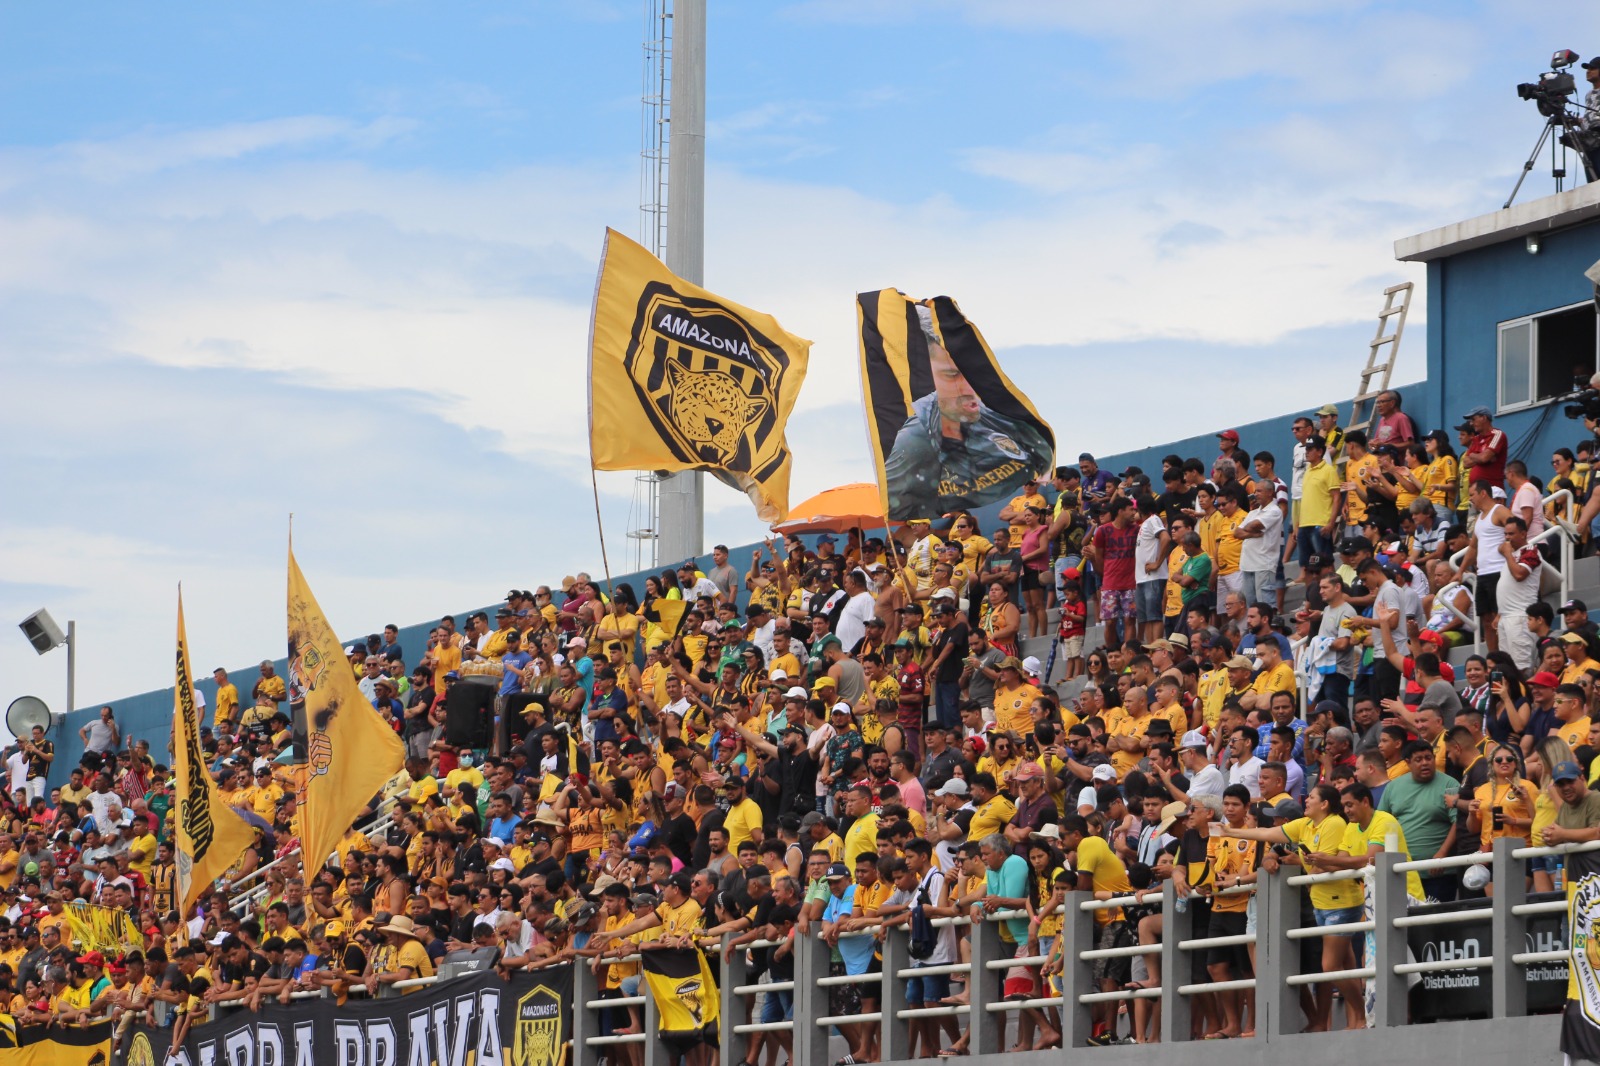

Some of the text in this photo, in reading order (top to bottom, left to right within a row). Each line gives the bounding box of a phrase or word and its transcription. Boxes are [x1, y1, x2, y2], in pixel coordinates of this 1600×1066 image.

[659, 313, 758, 366] AMAZONA
[971, 460, 1026, 492] ACERDA
[1425, 974, 1480, 989] Distribuidora
[1526, 967, 1569, 981] istribuido
[522, 1004, 550, 1016] AMAZONAS
